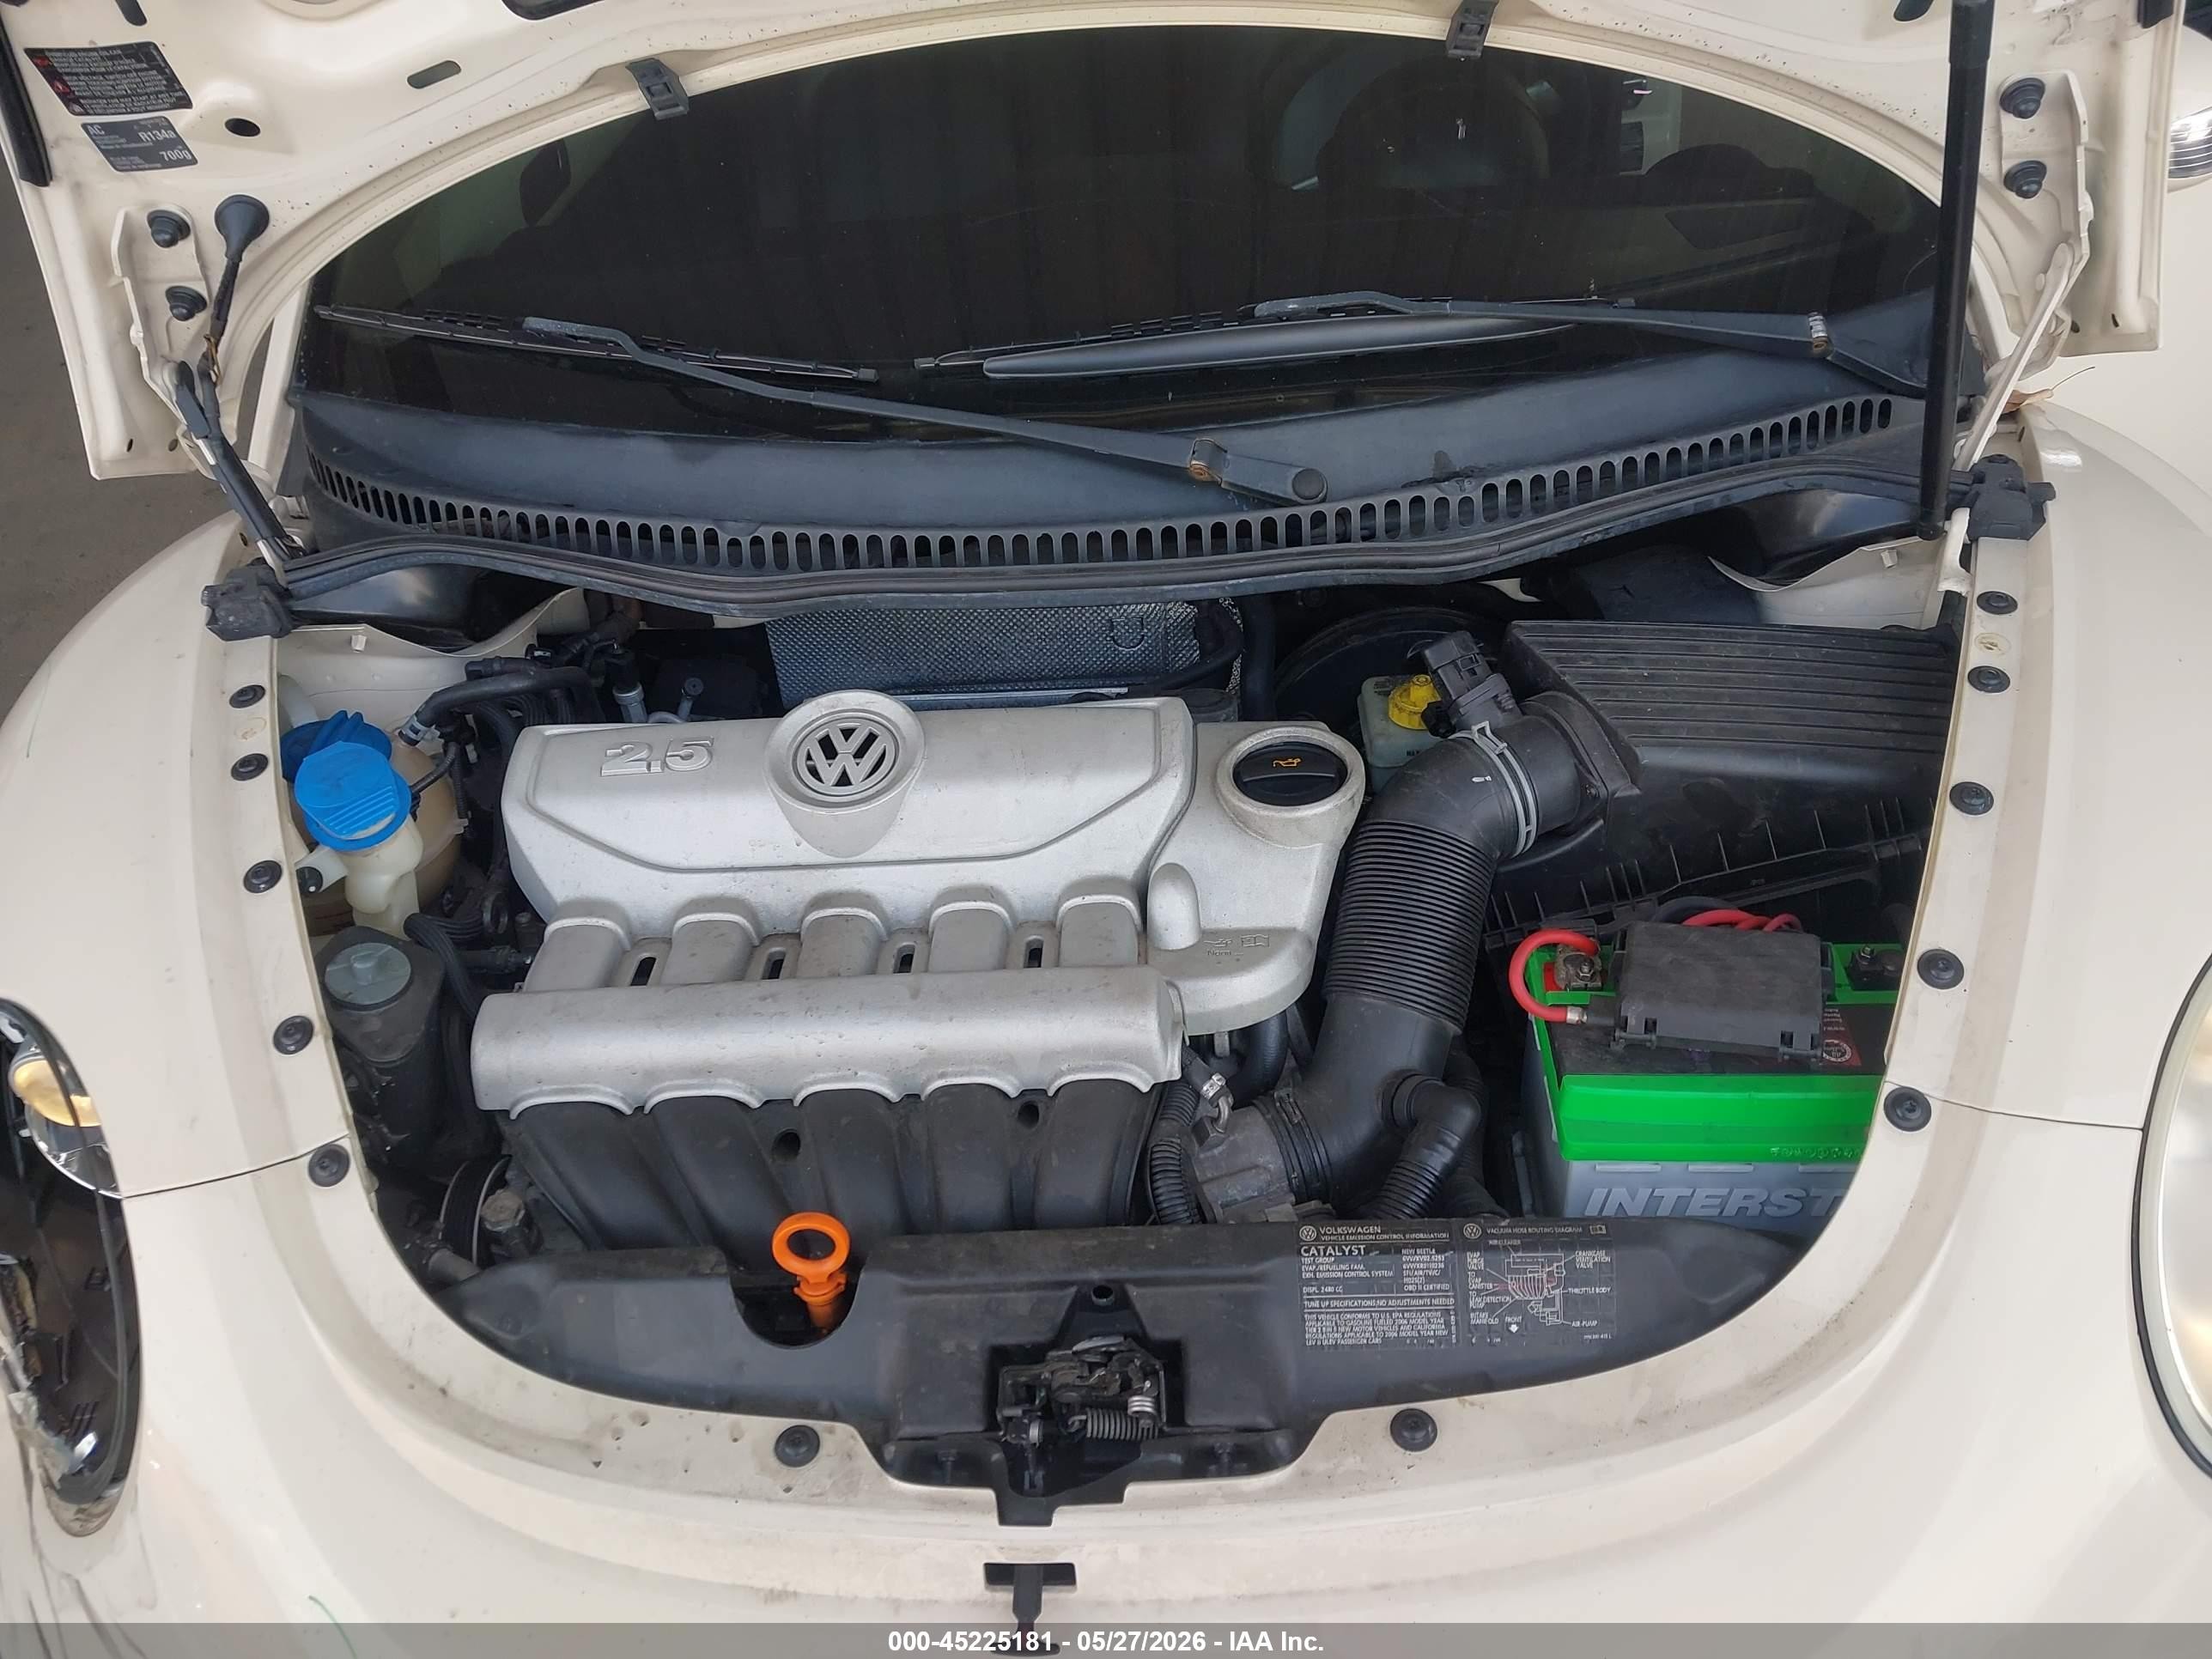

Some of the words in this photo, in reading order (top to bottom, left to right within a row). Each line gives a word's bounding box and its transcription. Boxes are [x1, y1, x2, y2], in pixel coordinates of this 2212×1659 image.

[86, 125, 105, 136] AC
[138, 129, 177, 143] R134a
[159, 149, 192, 162] 700g
[600, 737, 714, 776] 2.5
[1584, 1188, 1845, 1217] INTERST
[1319, 1225, 1381, 1235] VOLKSWAGEN
[1300, 1245, 1365, 1255] CATALYST
